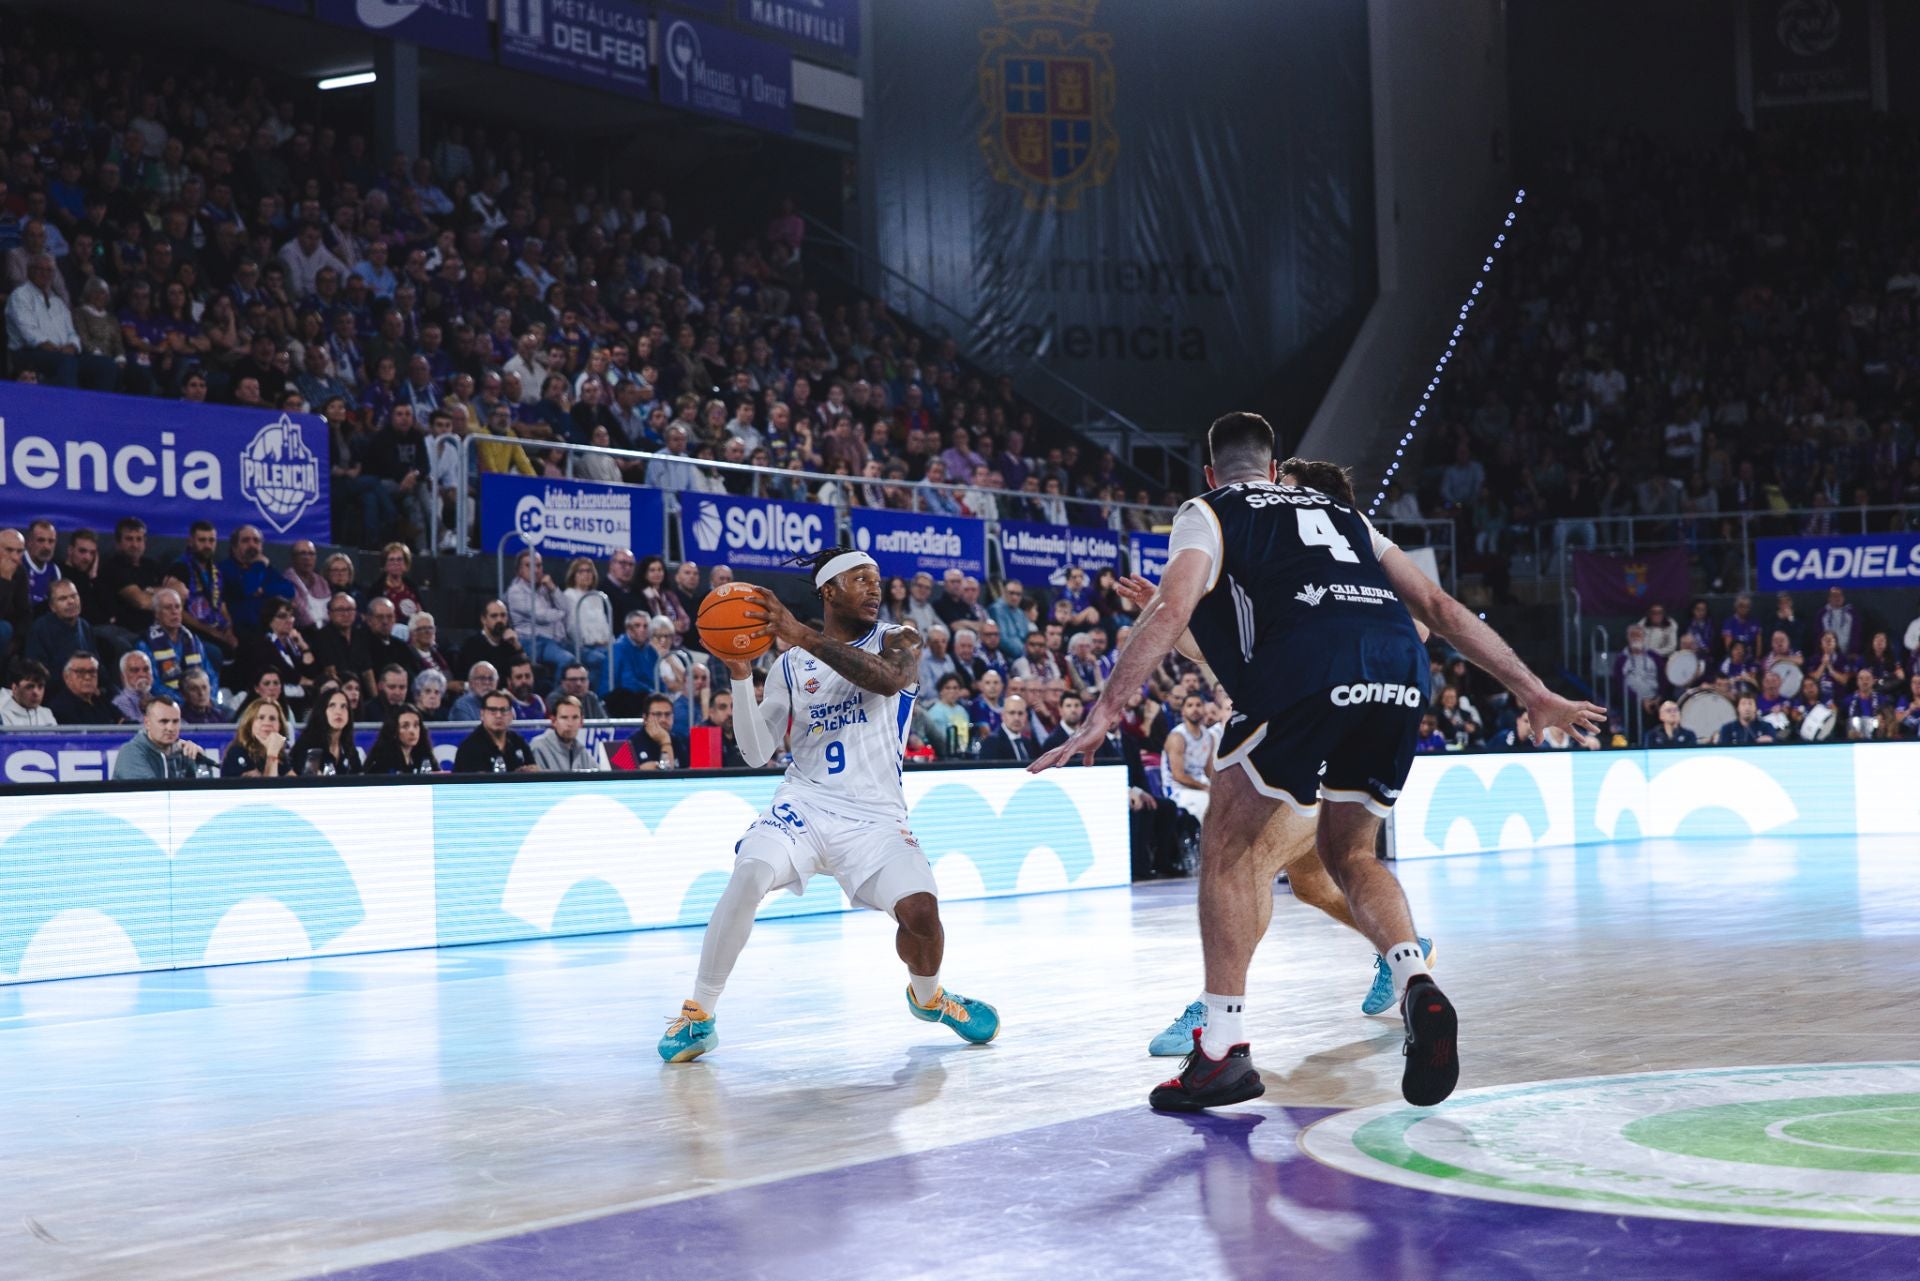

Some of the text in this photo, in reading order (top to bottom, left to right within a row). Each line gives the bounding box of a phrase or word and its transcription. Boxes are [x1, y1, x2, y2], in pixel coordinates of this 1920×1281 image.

[553, 21, 647, 71] DELFER
[244, 458, 317, 494] PALENCIA
[545, 514, 560, 529] EL
[563, 516, 615, 533] CRISTO
[725, 503, 823, 554] soltec
[1002, 529, 1018, 550] La
[1295, 508, 1361, 563] 4
[1329, 584, 1399, 602] CAJA RURAL
[810, 692, 863, 719] agropal
[825, 740, 846, 775] 9
